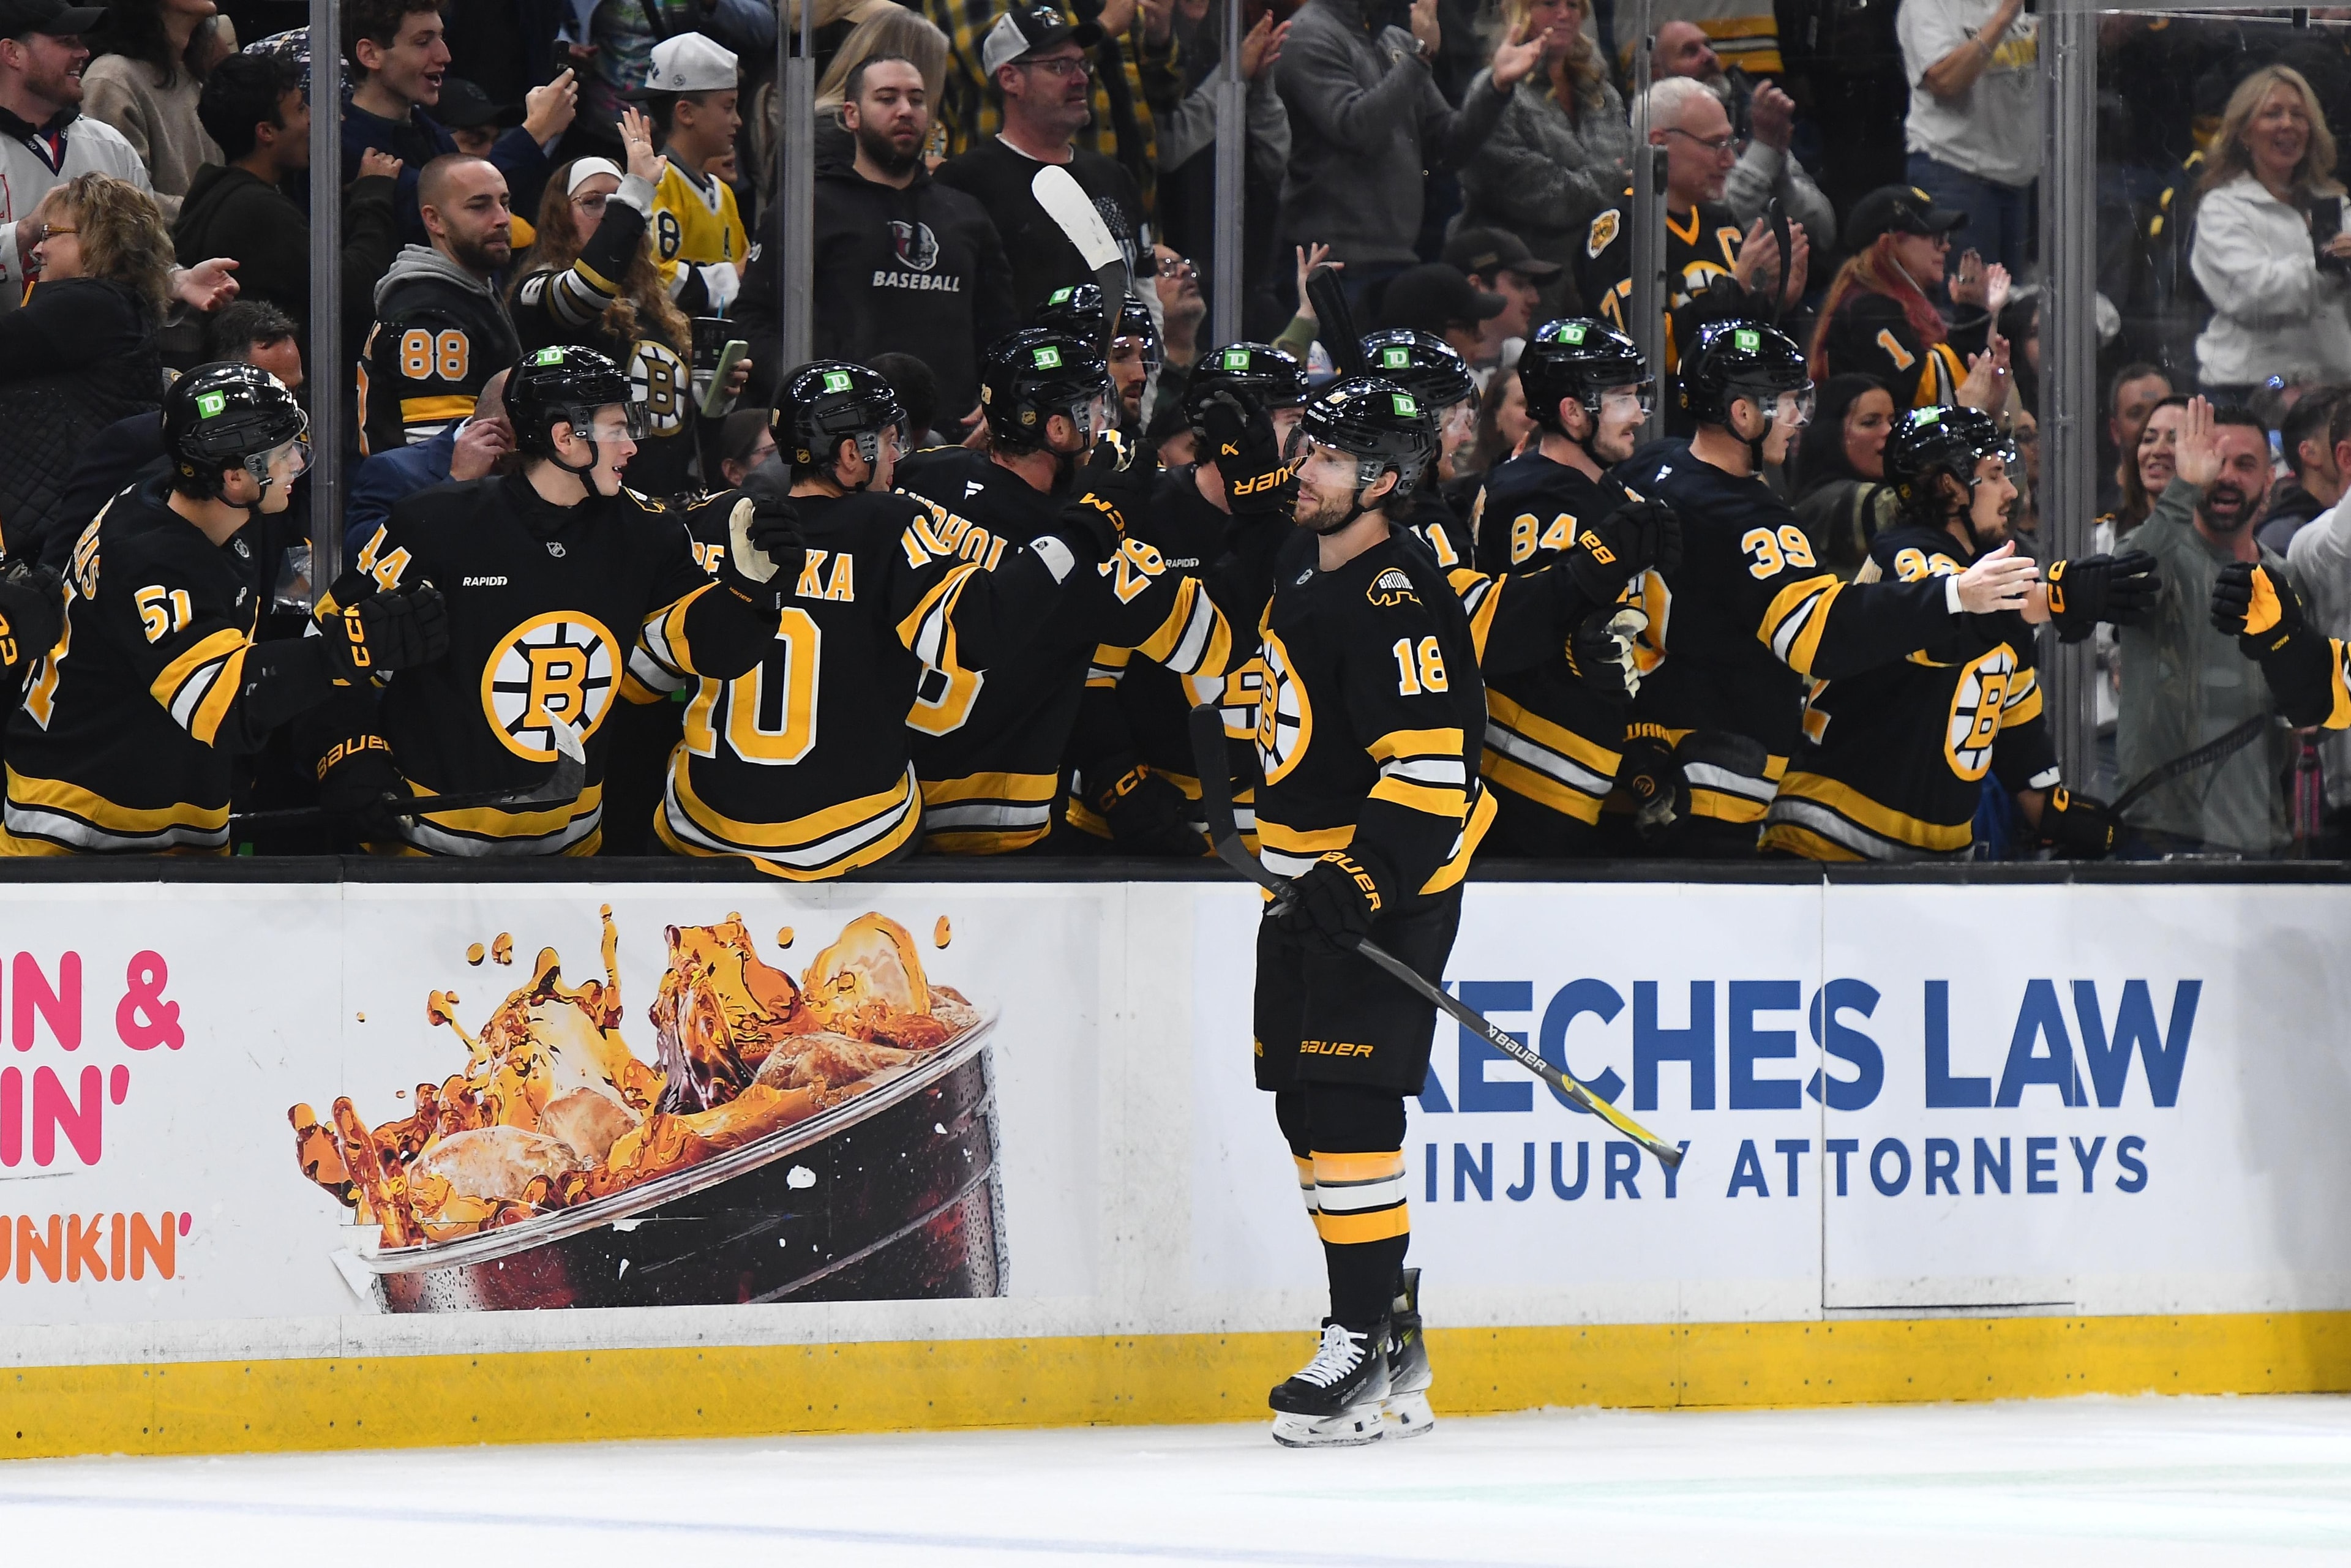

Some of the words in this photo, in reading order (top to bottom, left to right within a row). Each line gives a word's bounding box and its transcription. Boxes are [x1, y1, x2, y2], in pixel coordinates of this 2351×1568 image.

[873, 270, 959, 293] BASEBALL
[400, 328, 470, 381] 88
[1562, 328, 1583, 342] TD
[1739, 332, 1758, 346] TD
[541, 349, 561, 362] TD
[1228, 353, 1248, 366] TD
[1386, 350, 1408, 366] TD
[827, 373, 849, 389] TD
[200, 395, 223, 413] TD
[1395, 397, 1415, 413] TD
[356, 523, 412, 593] 44
[1511, 512, 1577, 566] 84
[1741, 525, 1817, 580] 39
[463, 576, 508, 587] RAPID7
[1097, 538, 1167, 605] 28
[134, 585, 193, 643] 51
[1393, 636, 1449, 696] 18
[1316, 852, 1382, 912] AUER
[116, 950, 185, 1051] &
[1299, 1040, 1374, 1058] BAUER
[1496, 1033, 1548, 1072] BAUER
[1924, 979, 2203, 1108] LAW
[1425, 1141, 1692, 1203] INJURY
[1726, 1135, 2149, 1198] ATTORNEYS
